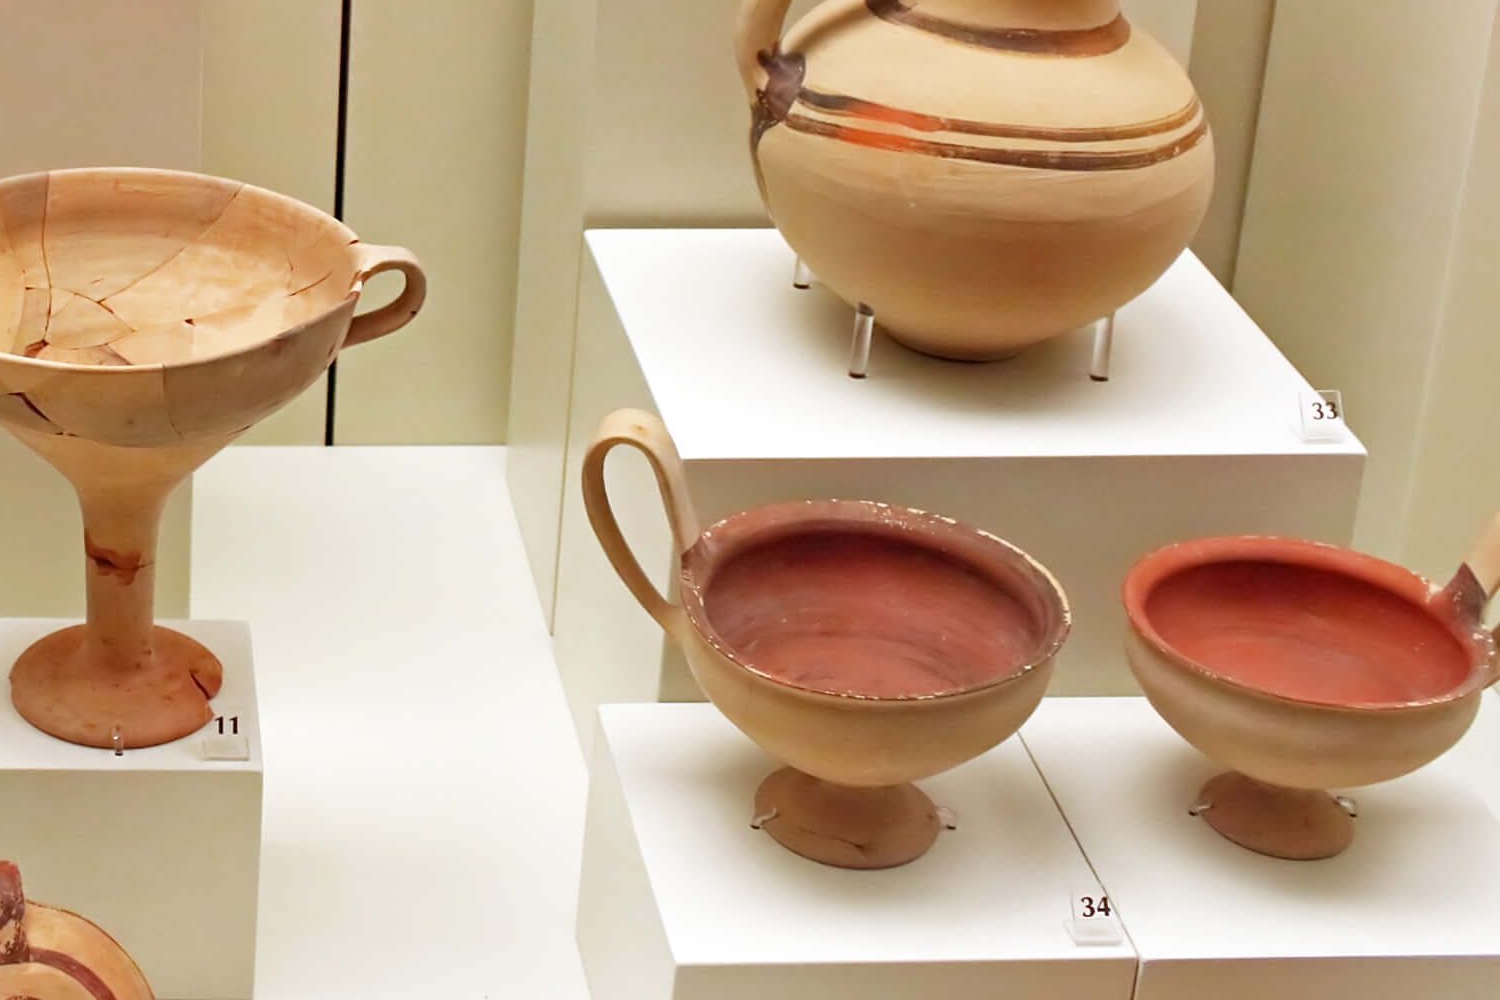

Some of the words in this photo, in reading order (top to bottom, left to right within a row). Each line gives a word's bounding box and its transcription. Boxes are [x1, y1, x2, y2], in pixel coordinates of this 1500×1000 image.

[1312, 402, 1341, 421] 33
[214, 715, 239, 735] 11
[1080, 896, 1111, 918] 34
